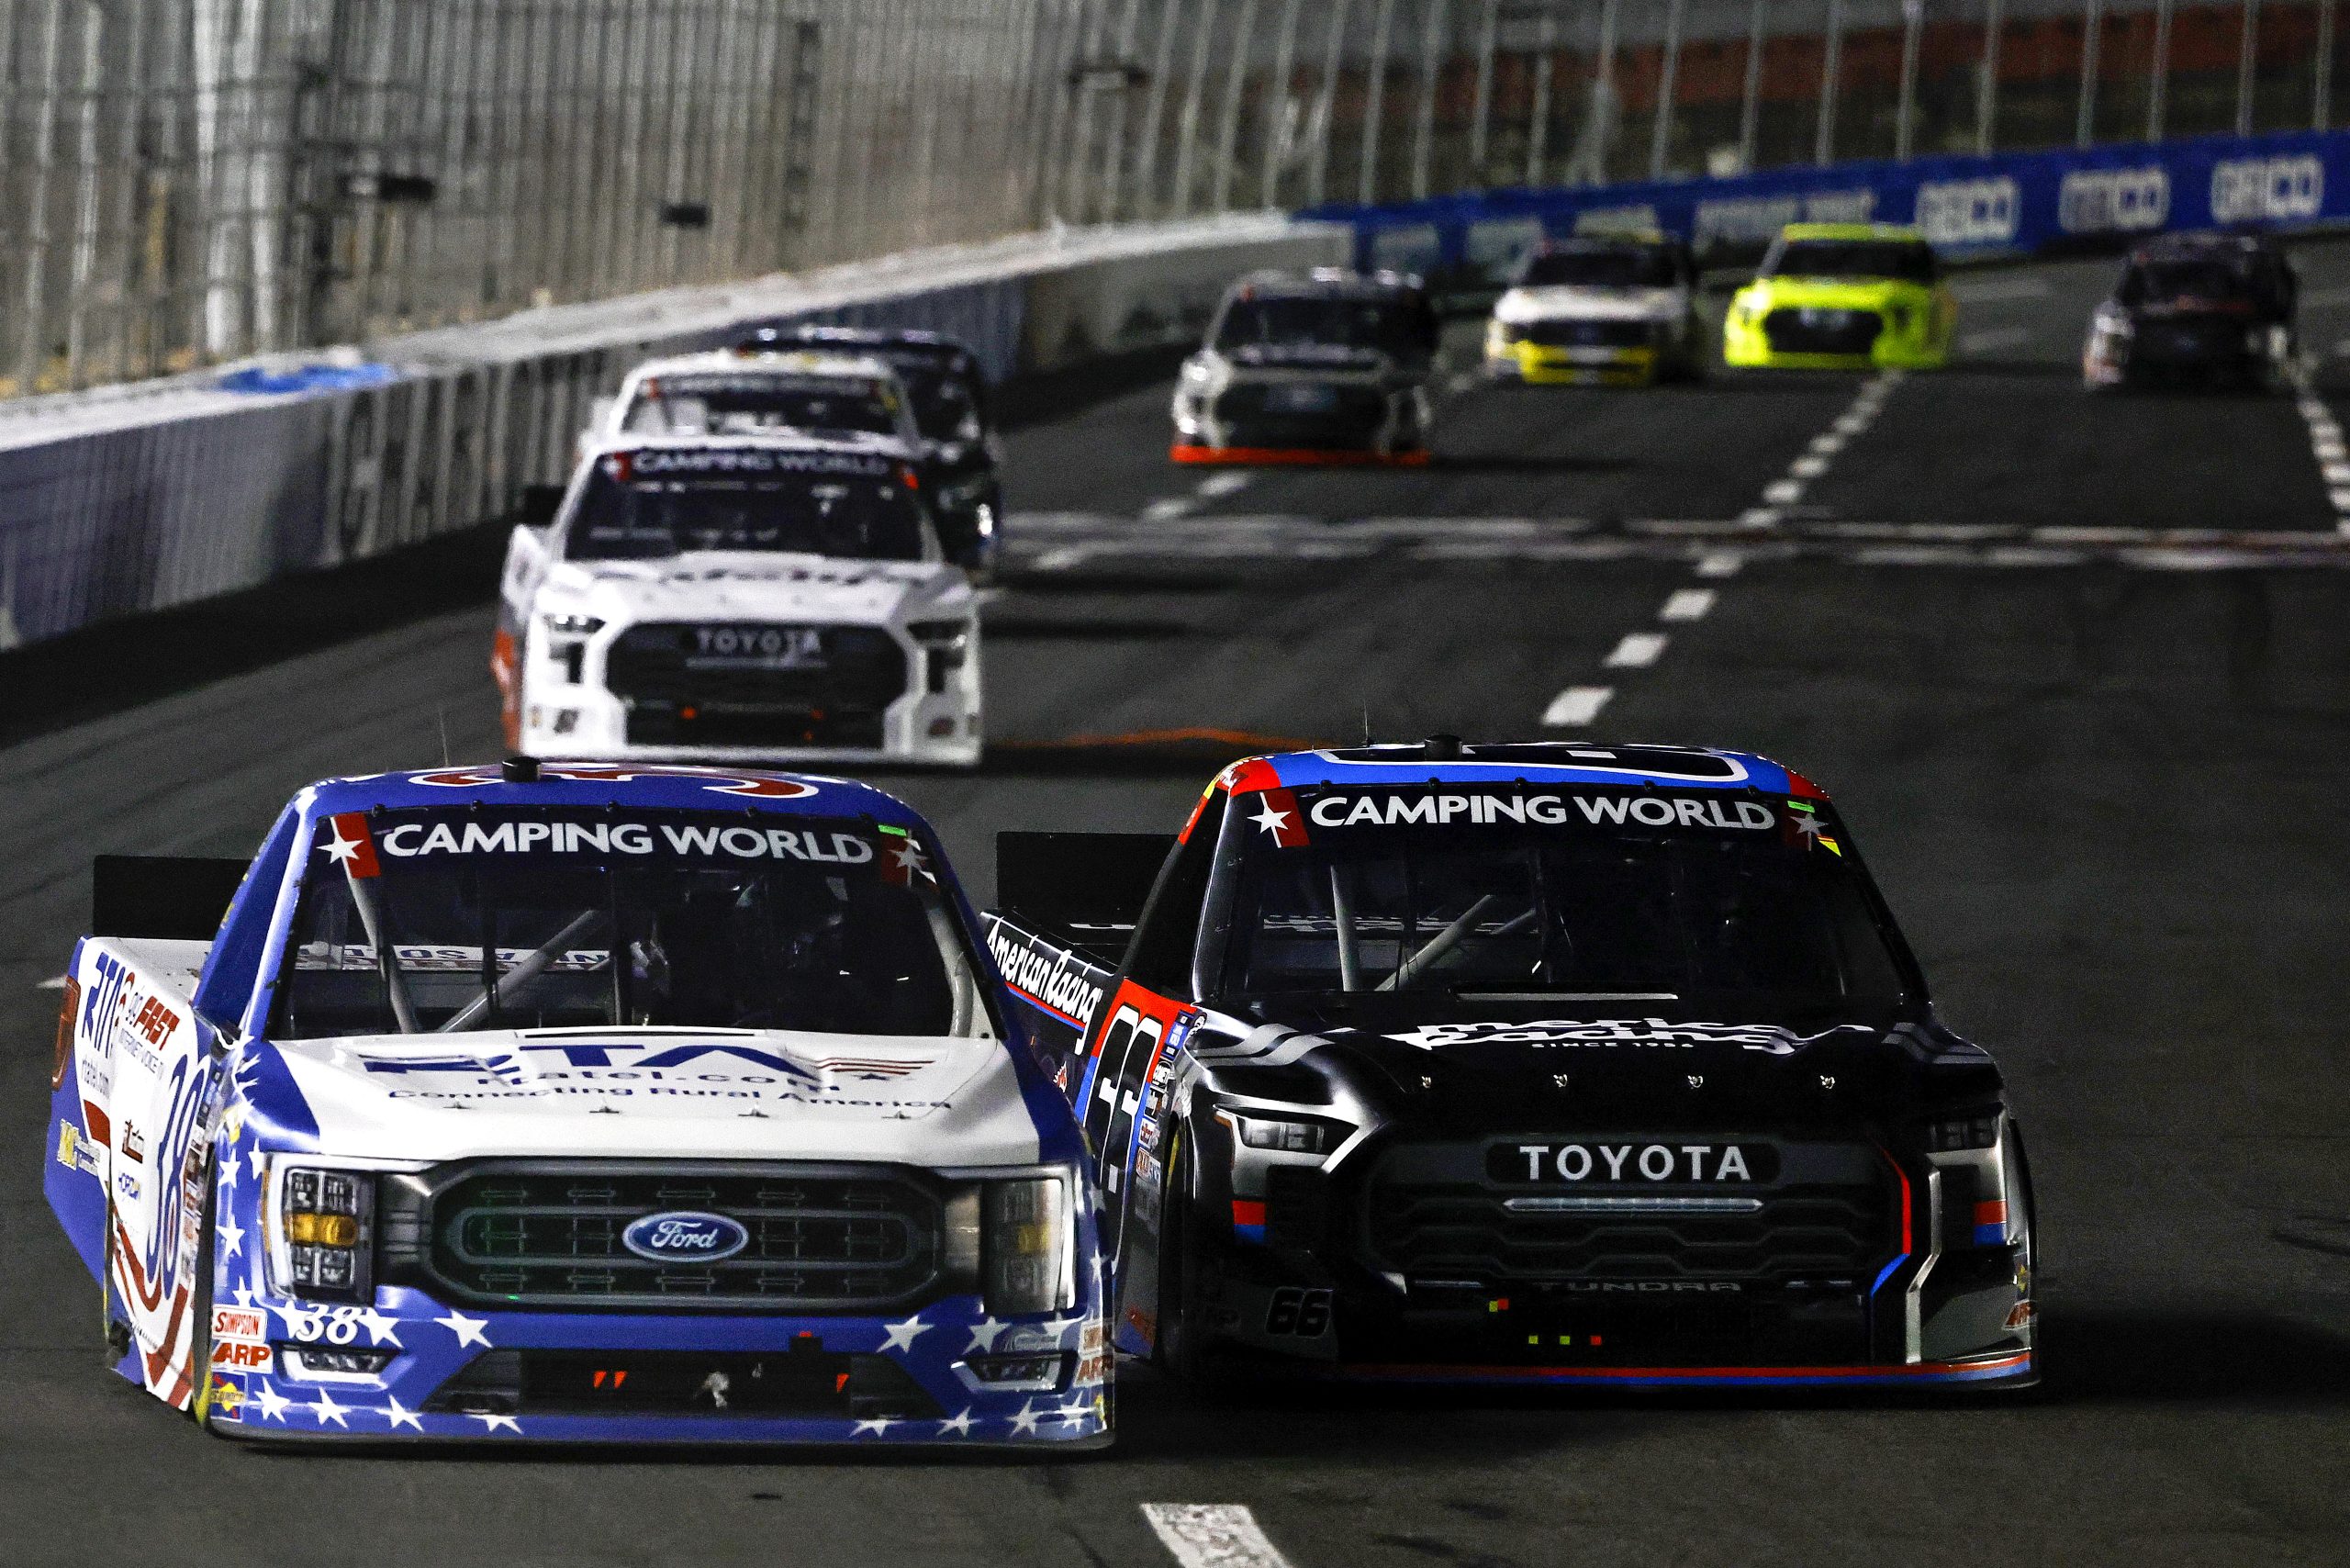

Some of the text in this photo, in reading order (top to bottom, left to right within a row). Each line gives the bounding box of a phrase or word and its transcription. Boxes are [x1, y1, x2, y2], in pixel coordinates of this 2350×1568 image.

[696, 627, 822, 653] TOYOTA
[1311, 795, 1775, 830] CAMPING WORLD
[383, 822, 872, 864] CAMPING WORLD
[986, 916, 1103, 1055] American Racing
[648, 1087, 761, 1098] Rural
[1519, 1145, 1751, 1181] TOYOTA
[651, 1220, 719, 1249] Ford
[296, 1303, 364, 1345] 38
[212, 1342, 272, 1367] ARP
